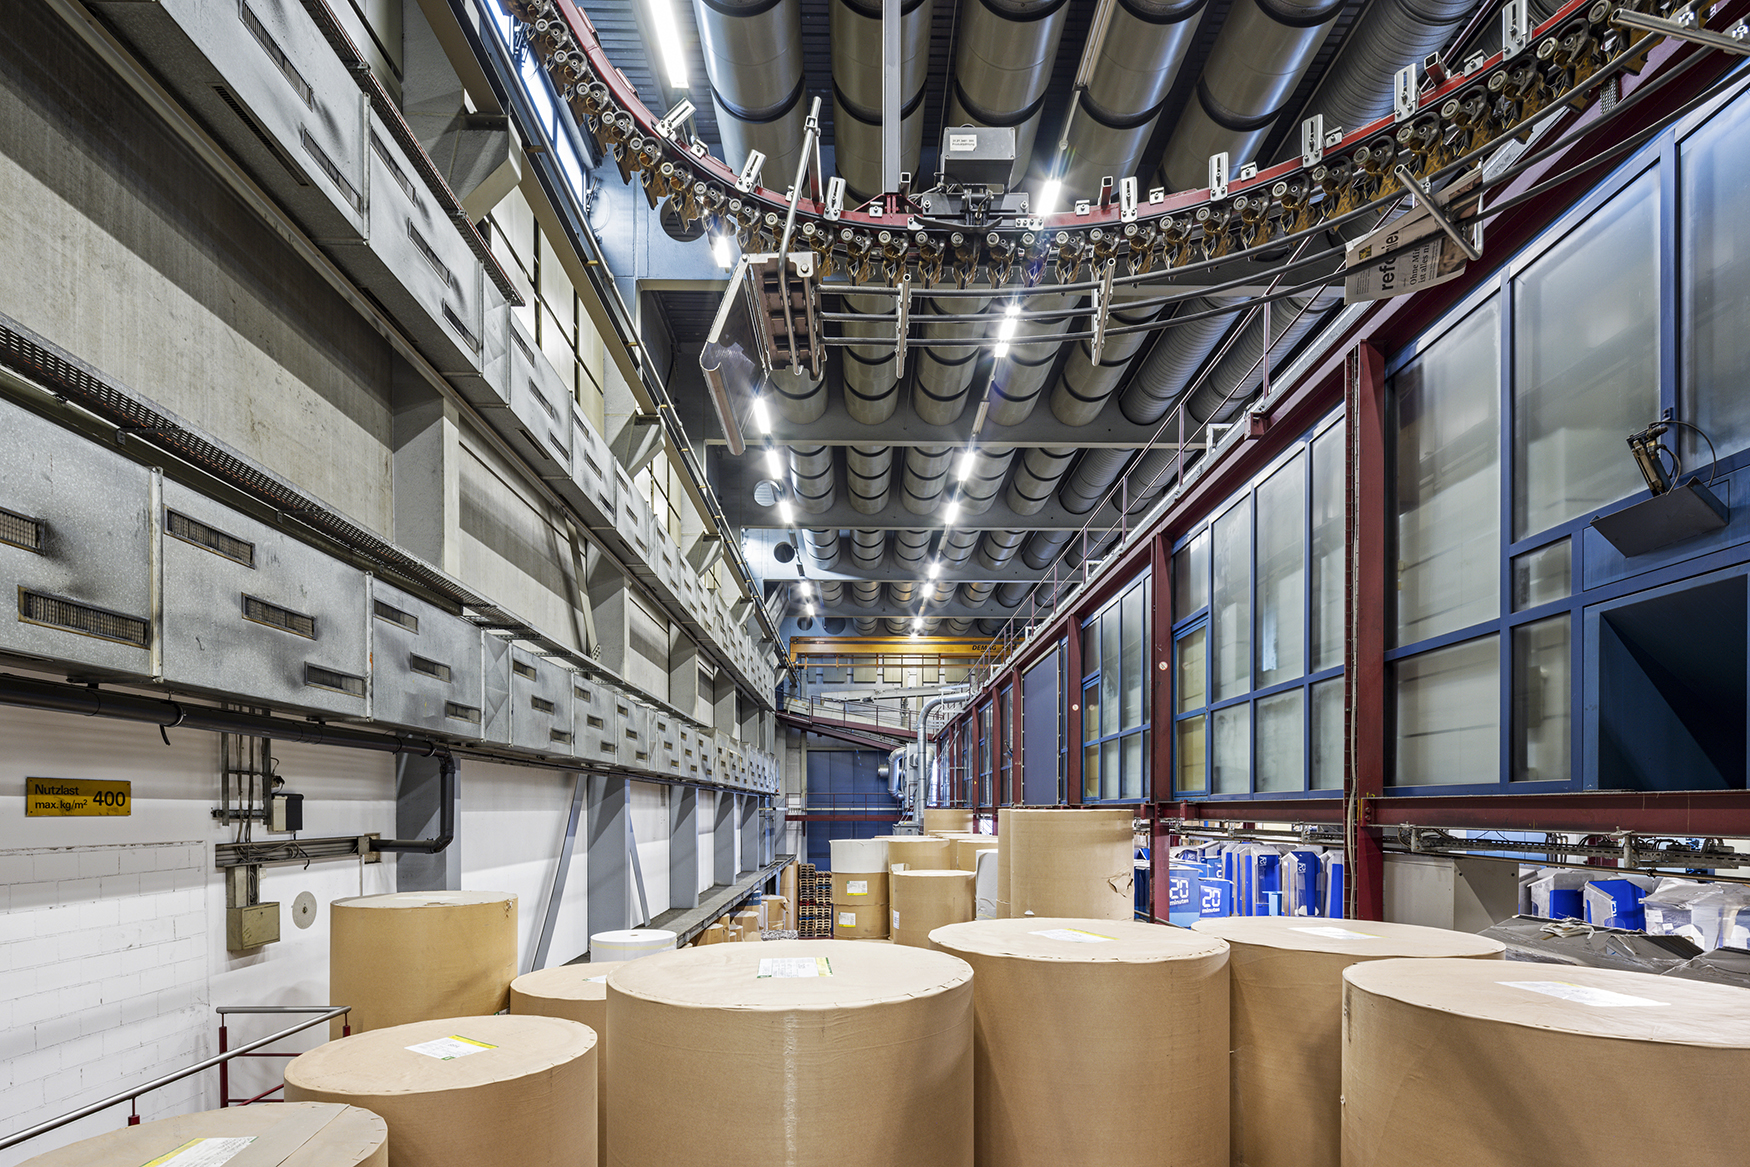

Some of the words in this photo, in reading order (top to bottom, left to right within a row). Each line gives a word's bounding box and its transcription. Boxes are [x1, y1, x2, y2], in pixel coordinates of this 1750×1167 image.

[35, 784, 79, 795] Nutzlast
[92, 791, 126, 807] 400
[1169, 878, 1189, 899] 20
[1202, 888, 1220, 907] 20
[1169, 898, 1190, 906] minutes
